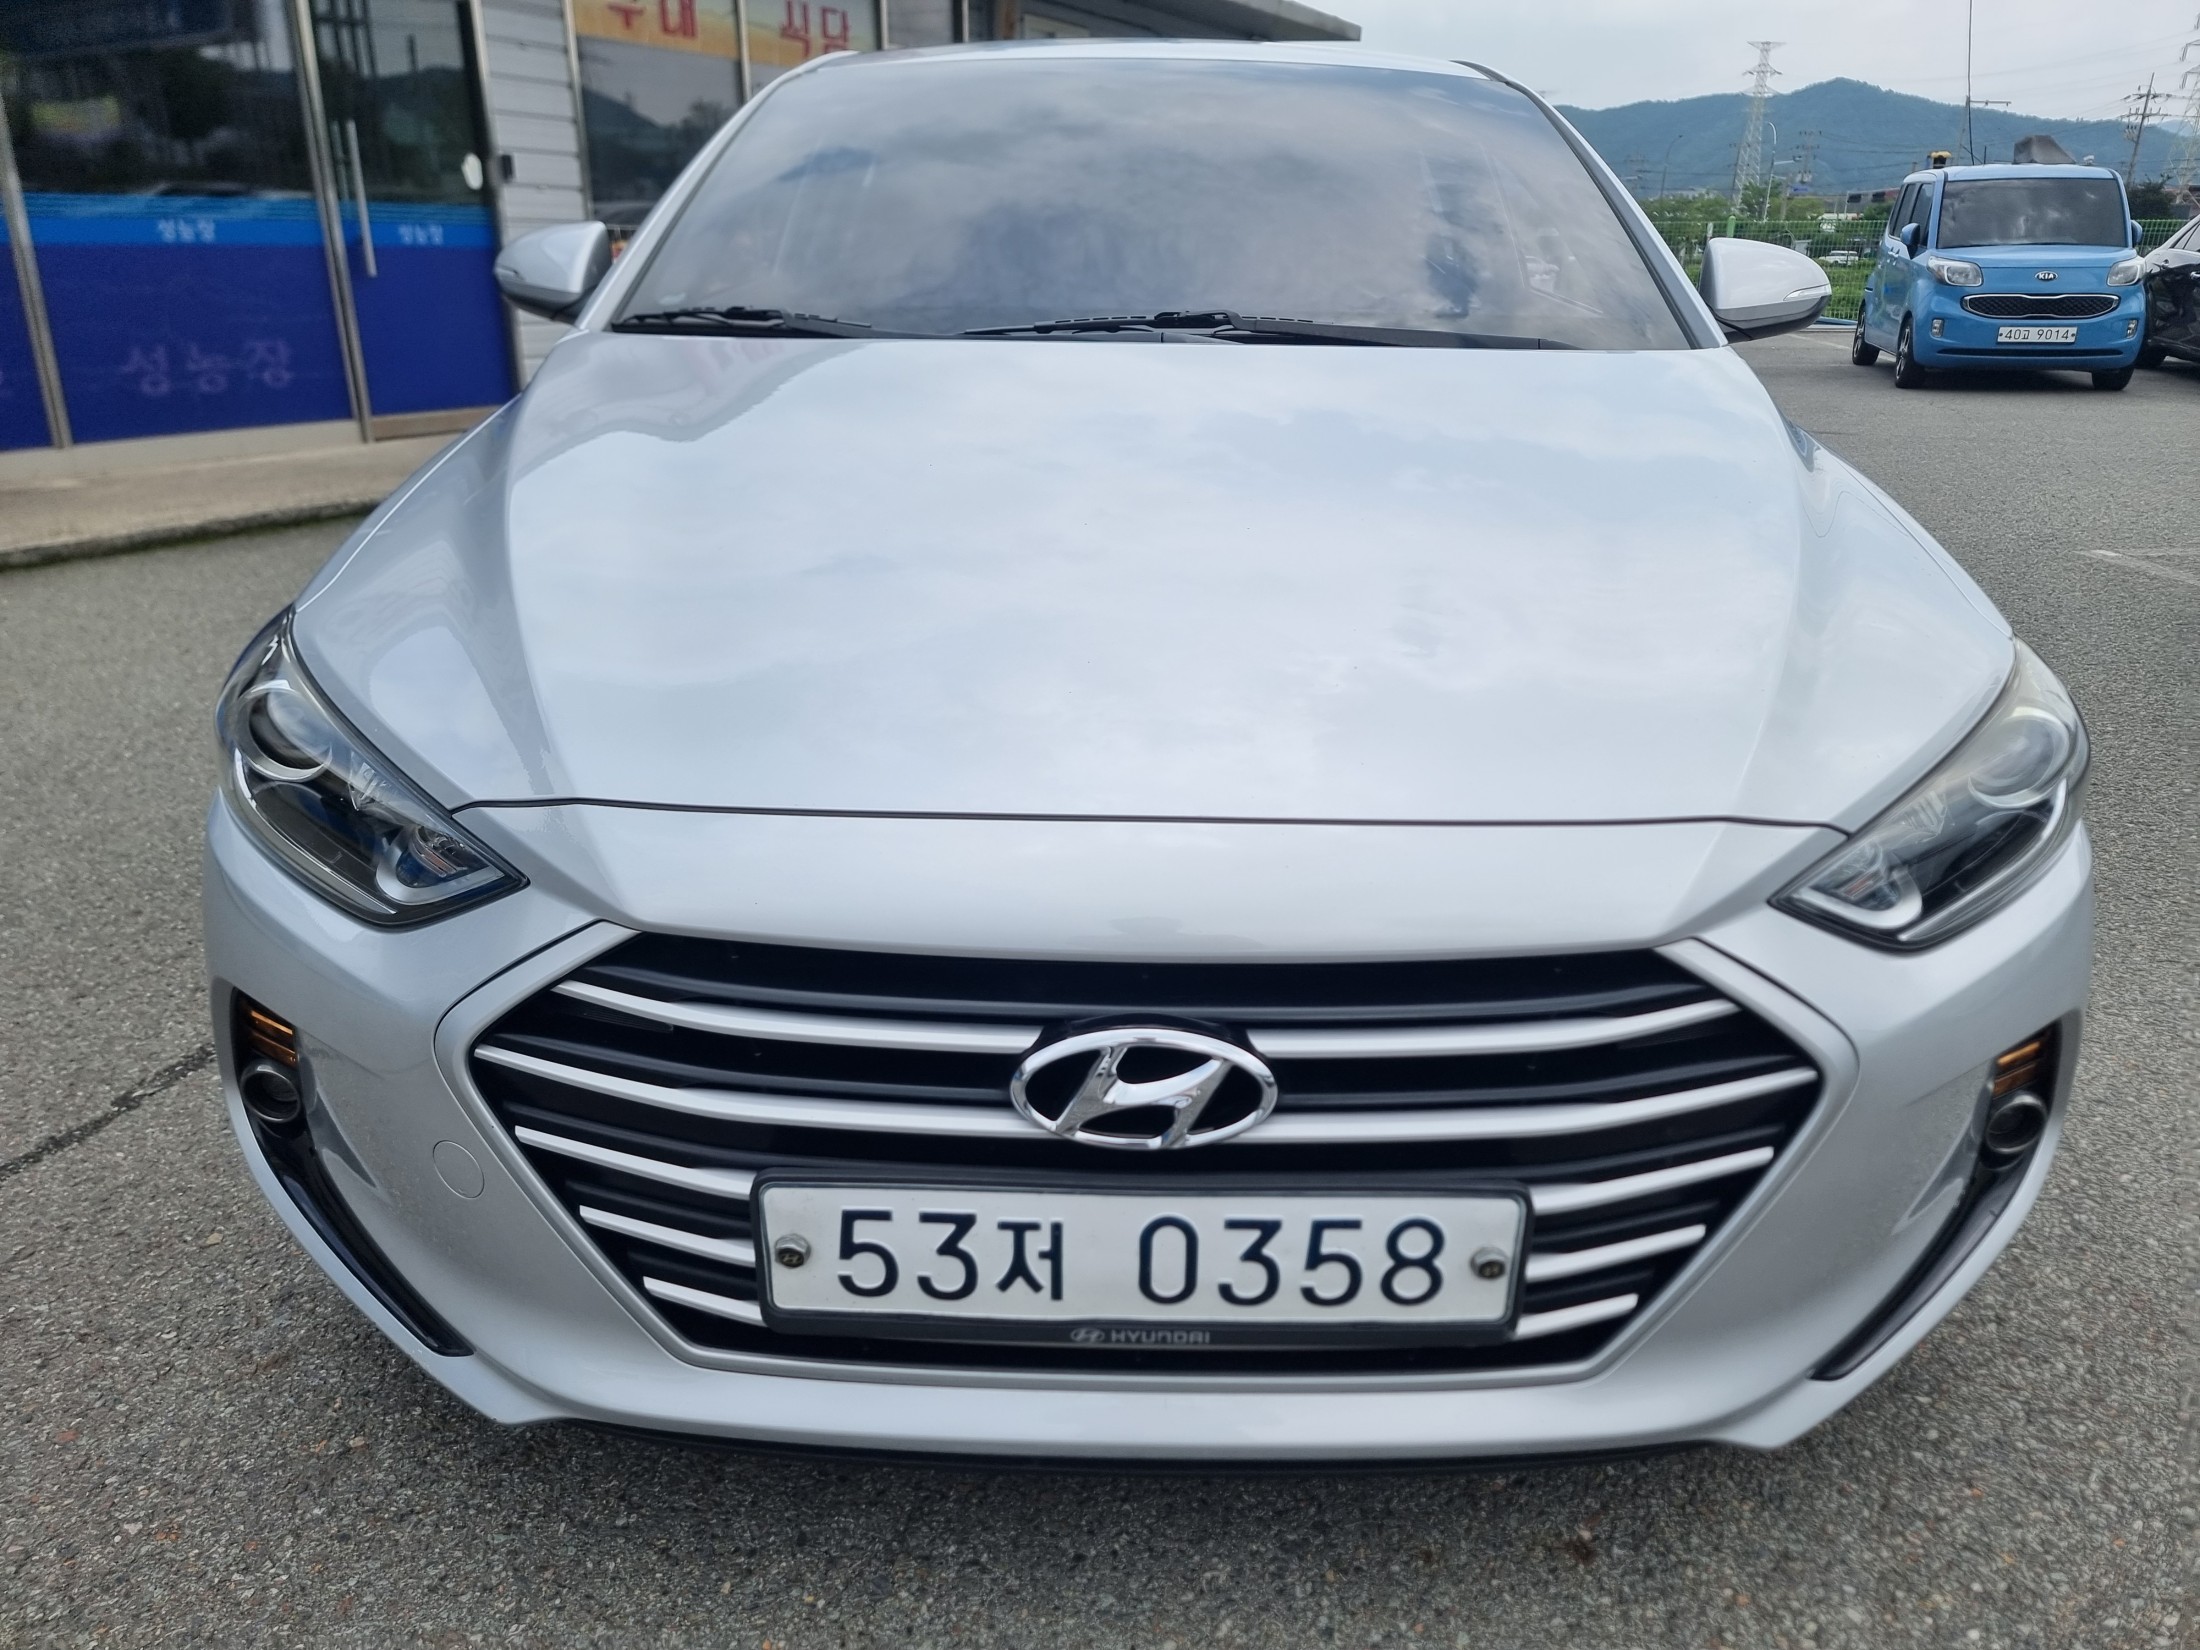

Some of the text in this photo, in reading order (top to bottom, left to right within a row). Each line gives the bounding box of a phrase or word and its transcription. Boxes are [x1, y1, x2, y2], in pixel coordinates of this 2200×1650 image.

[2004, 329, 2070, 340] 40고 9014
[836, 1208, 1447, 1307] 53저 0358
[1111, 1329, 1211, 1344] HYUNDAI
